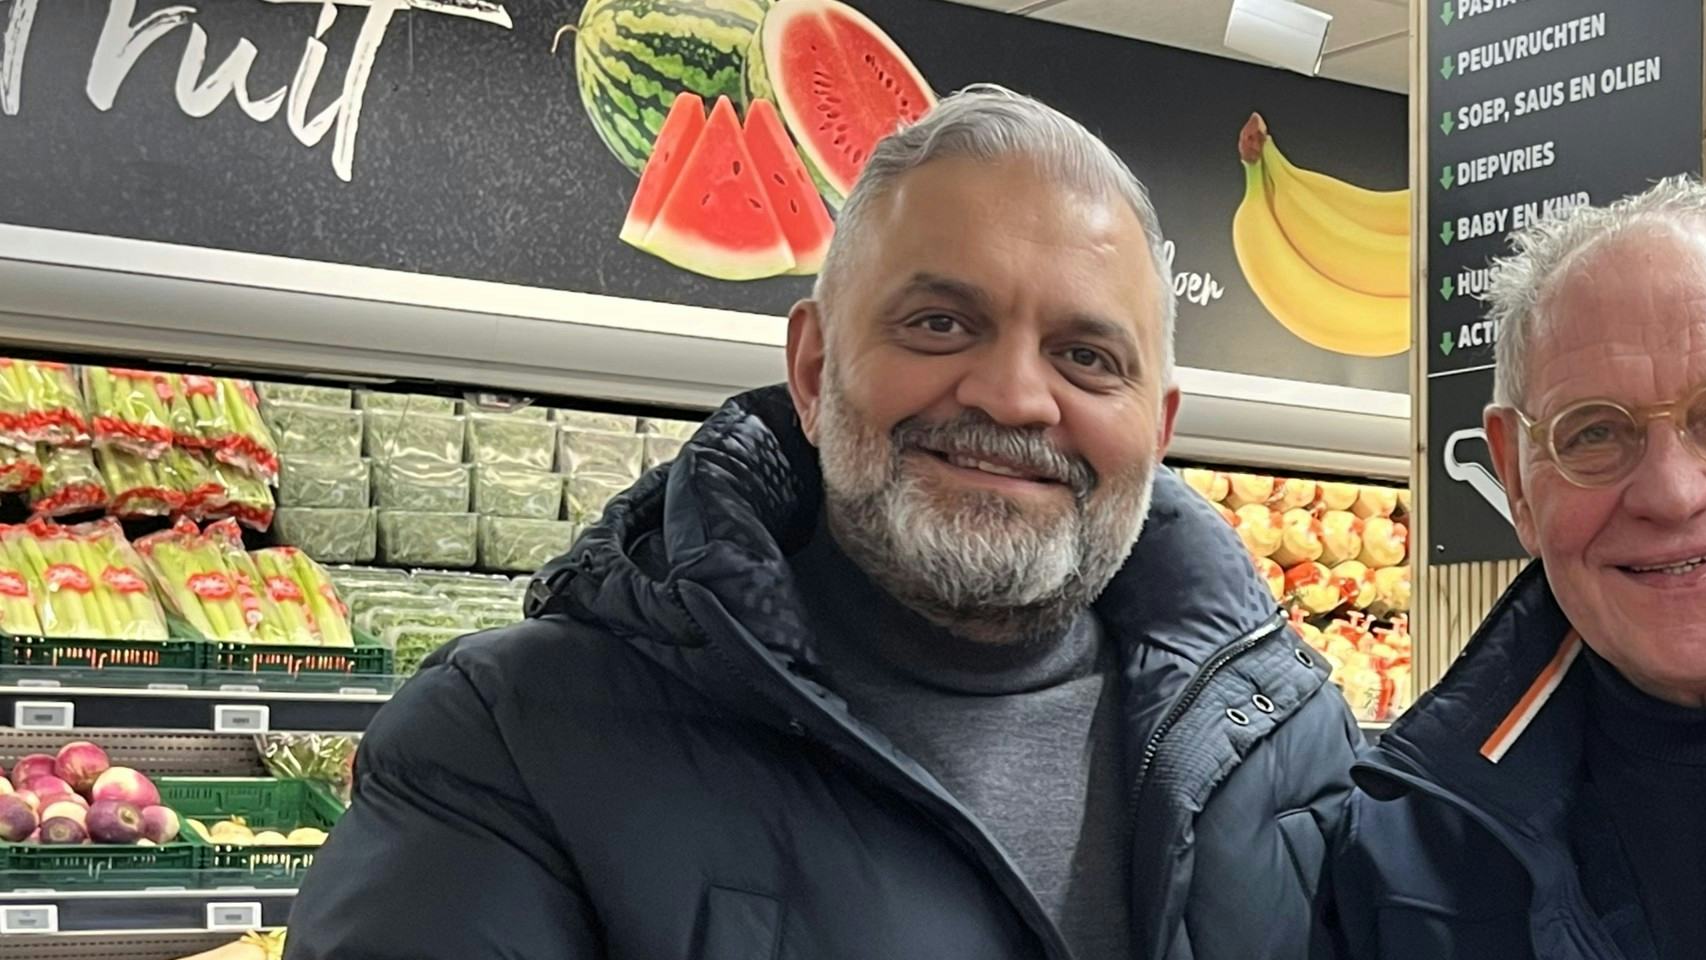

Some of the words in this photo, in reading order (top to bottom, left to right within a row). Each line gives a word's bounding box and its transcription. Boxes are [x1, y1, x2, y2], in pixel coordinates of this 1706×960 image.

[1457, 12, 1606, 76] PEULVRUCHTEN
[1457, 97, 1509, 130] SOEP,
[1514, 81, 1565, 116] SAUS
[1569, 73, 1596, 102] EN
[1600, 56, 1661, 94] OLIEN
[1457, 141, 1555, 187] DIEPVRIES
[1457, 208, 1508, 241] BABY
[1512, 202, 1538, 229] EN
